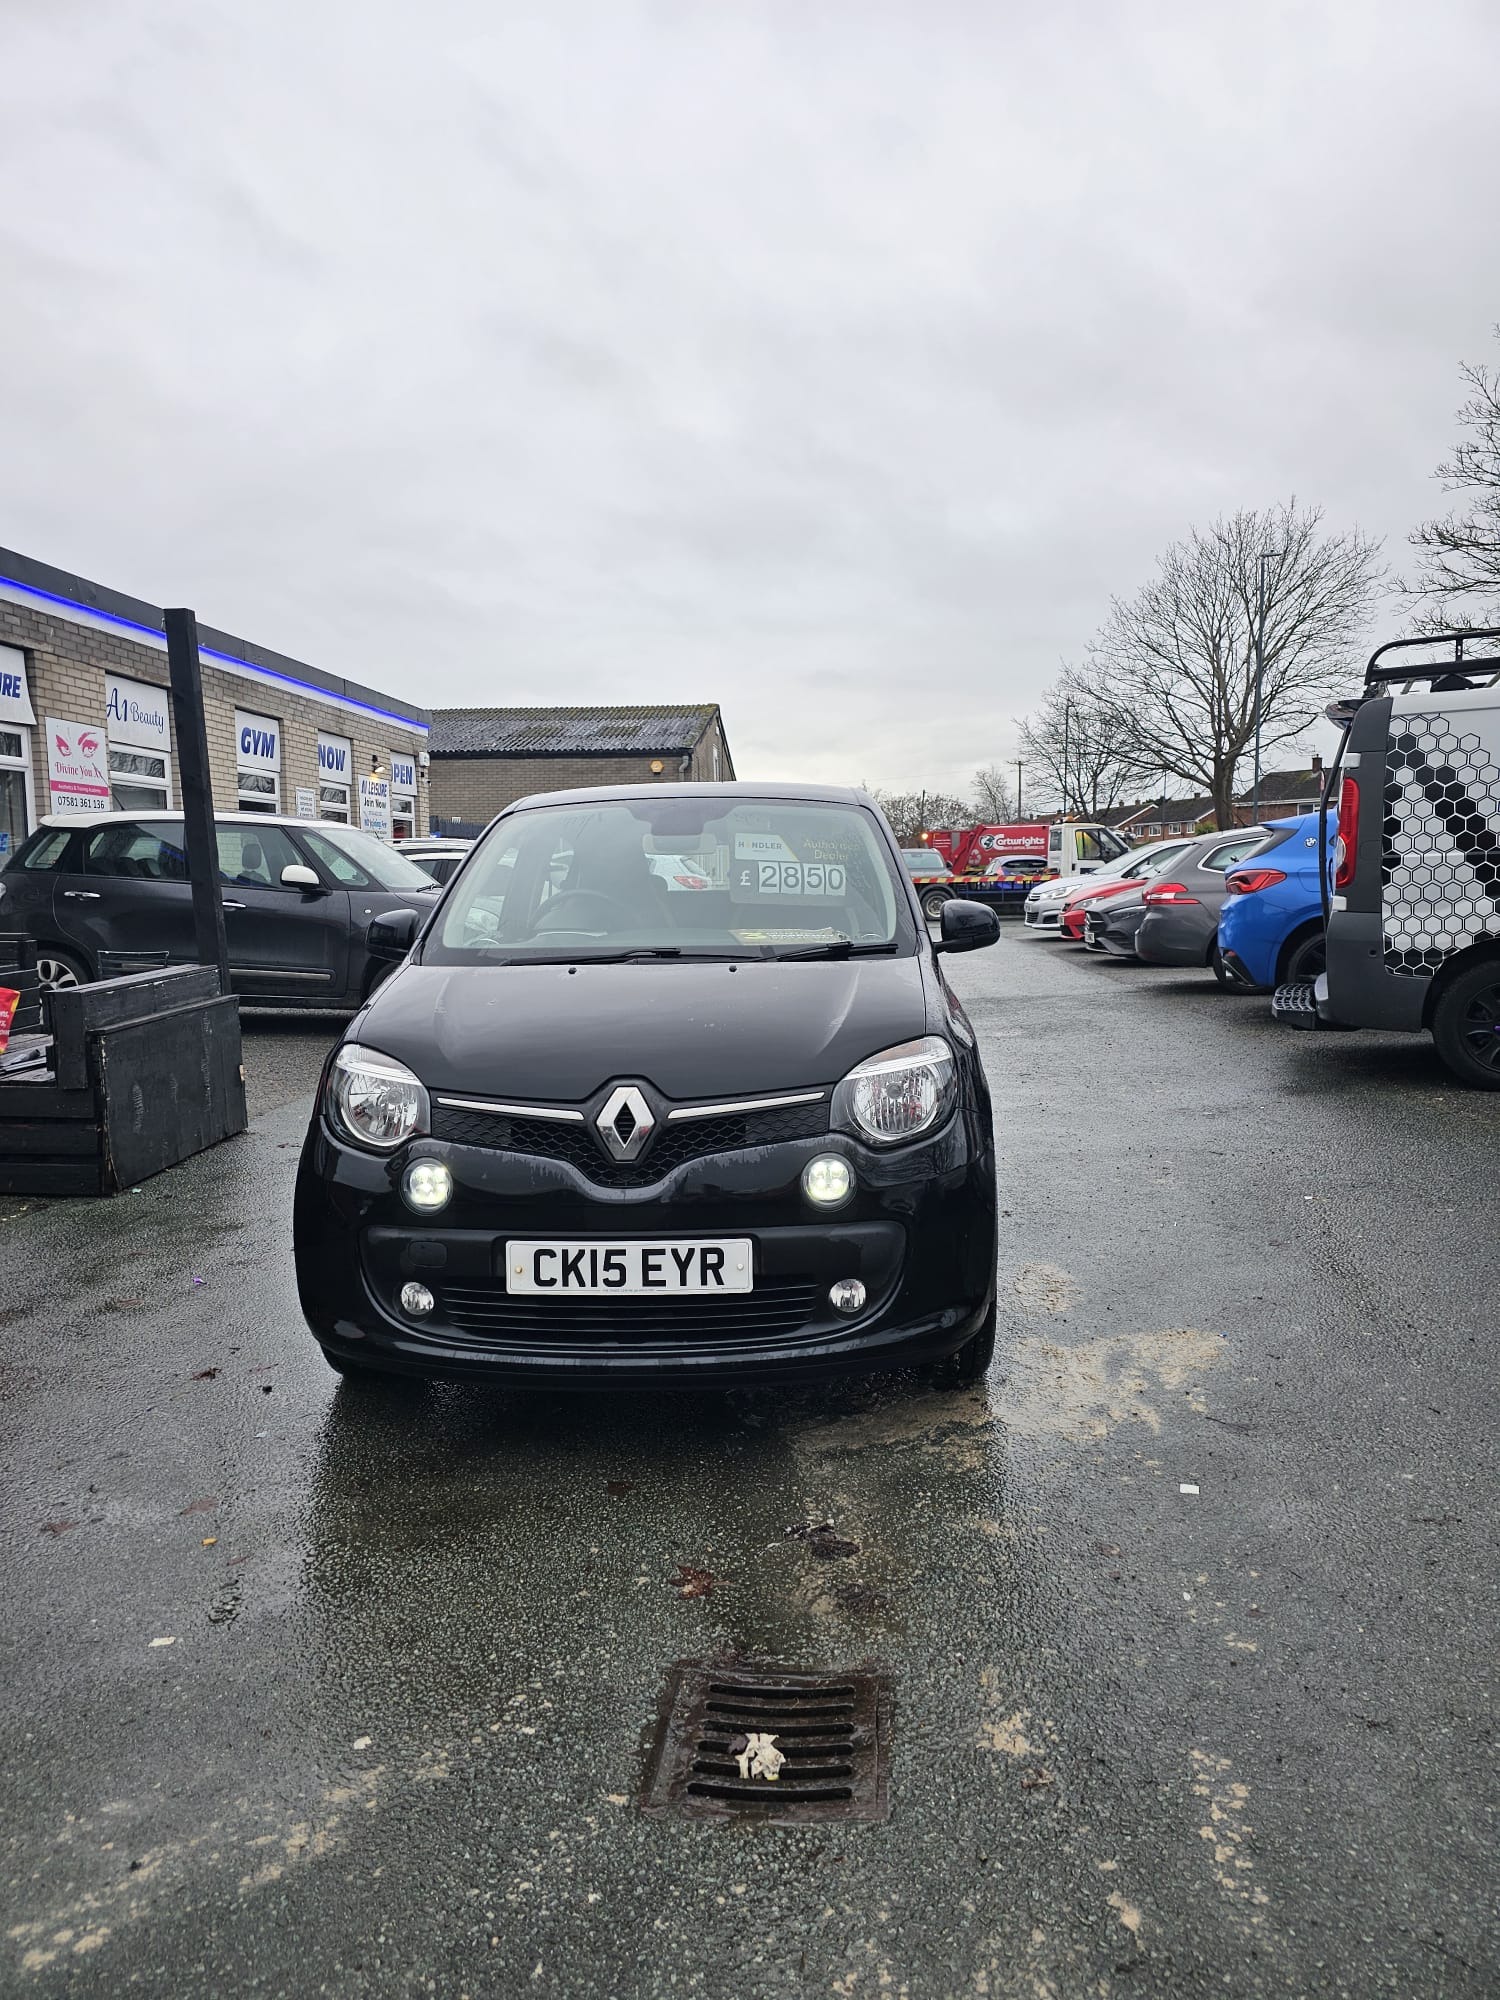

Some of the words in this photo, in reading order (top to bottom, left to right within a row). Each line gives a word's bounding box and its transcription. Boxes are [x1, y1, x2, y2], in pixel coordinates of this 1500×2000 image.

[0, 672, 21, 698] RE
[106, 688, 127, 722] A1
[130, 701, 164, 734] Beauty
[240, 727, 275, 759] GYM
[55, 761, 78, 775] Divine
[79, 765, 92, 779] You
[318, 744, 345, 772] NOW
[58, 796, 78, 807] 07581
[80, 798, 91, 808] 361
[93, 800, 105, 810] 136
[738, 841, 783, 850] HNDLER
[993, 834, 1045, 850] Cartwrights
[761, 865, 844, 890] 2850
[533, 1248, 627, 1288] CK15
[642, 1247, 725, 1287] EYR
